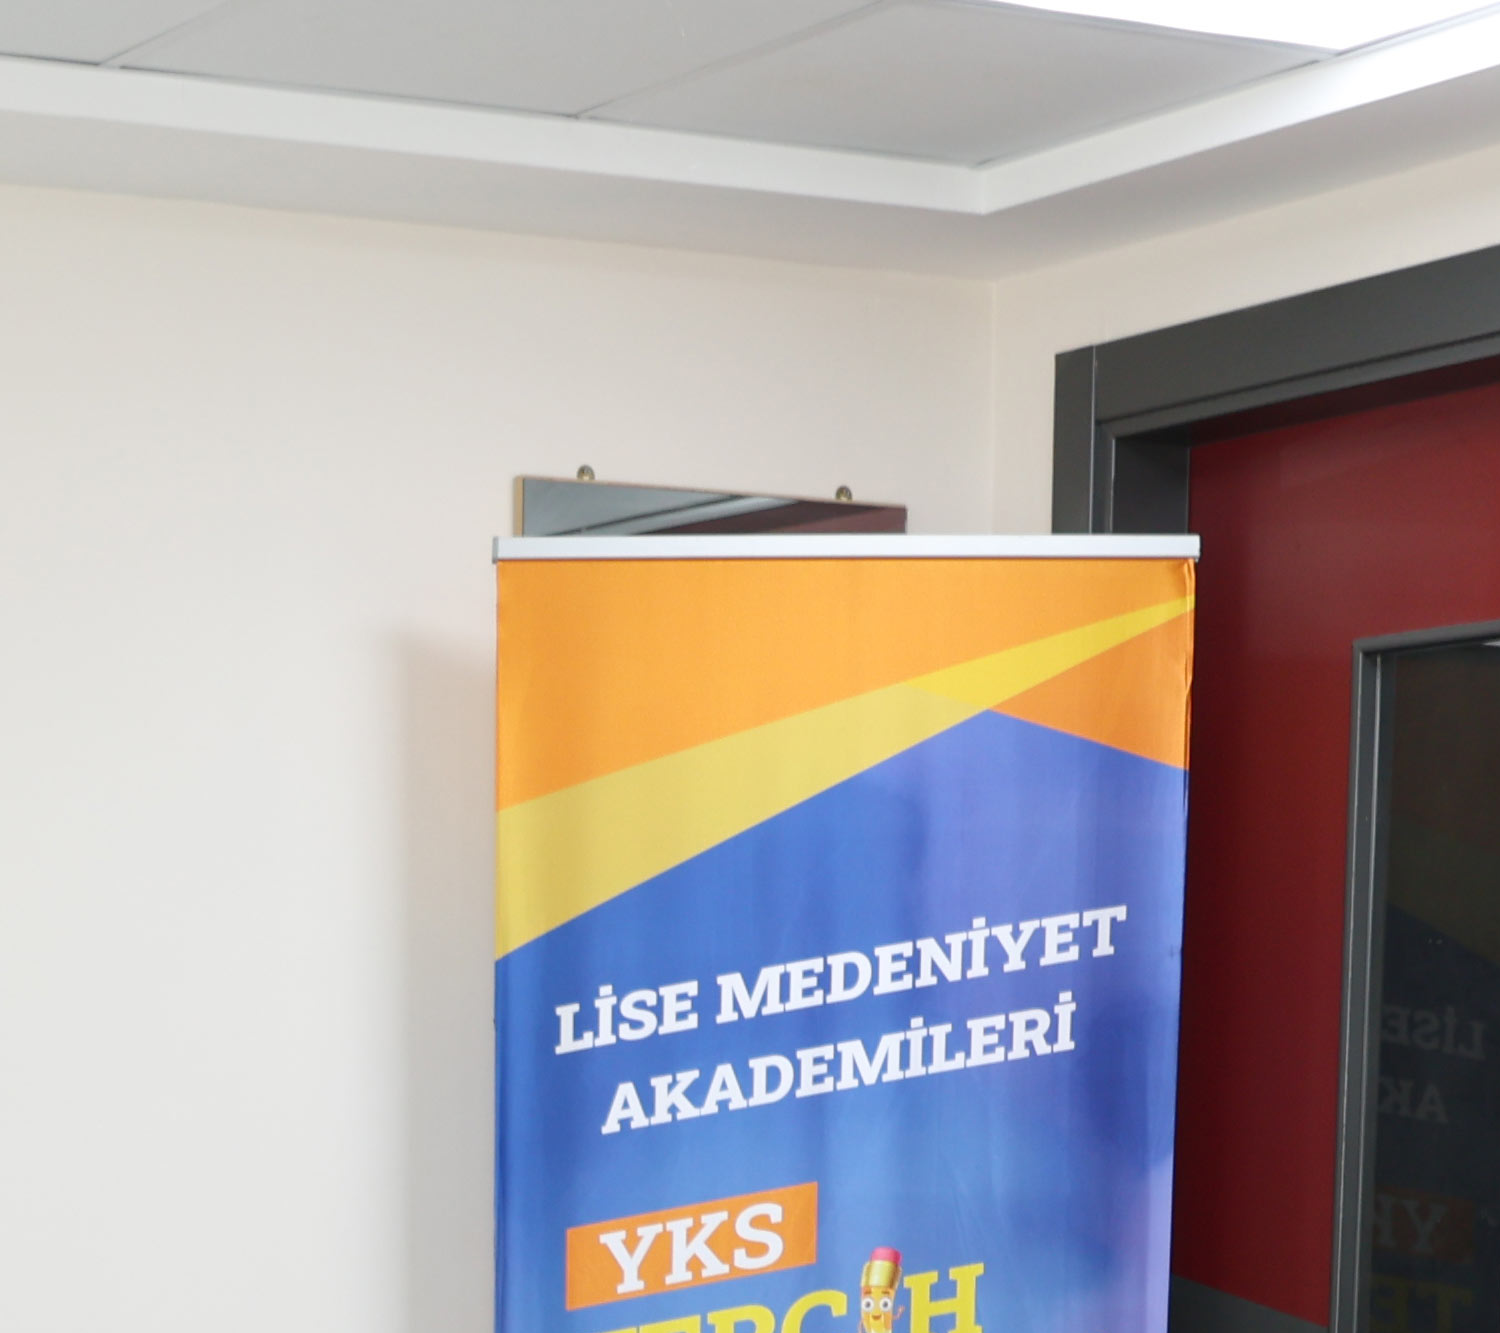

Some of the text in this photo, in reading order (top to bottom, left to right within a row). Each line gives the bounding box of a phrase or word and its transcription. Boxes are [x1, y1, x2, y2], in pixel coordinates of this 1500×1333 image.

[554, 904, 1127, 1055] LİSE MEDENİYET
[601, 990, 1077, 1135] AKADEMİLERİ
[599, 1202, 785, 1295] YKS
